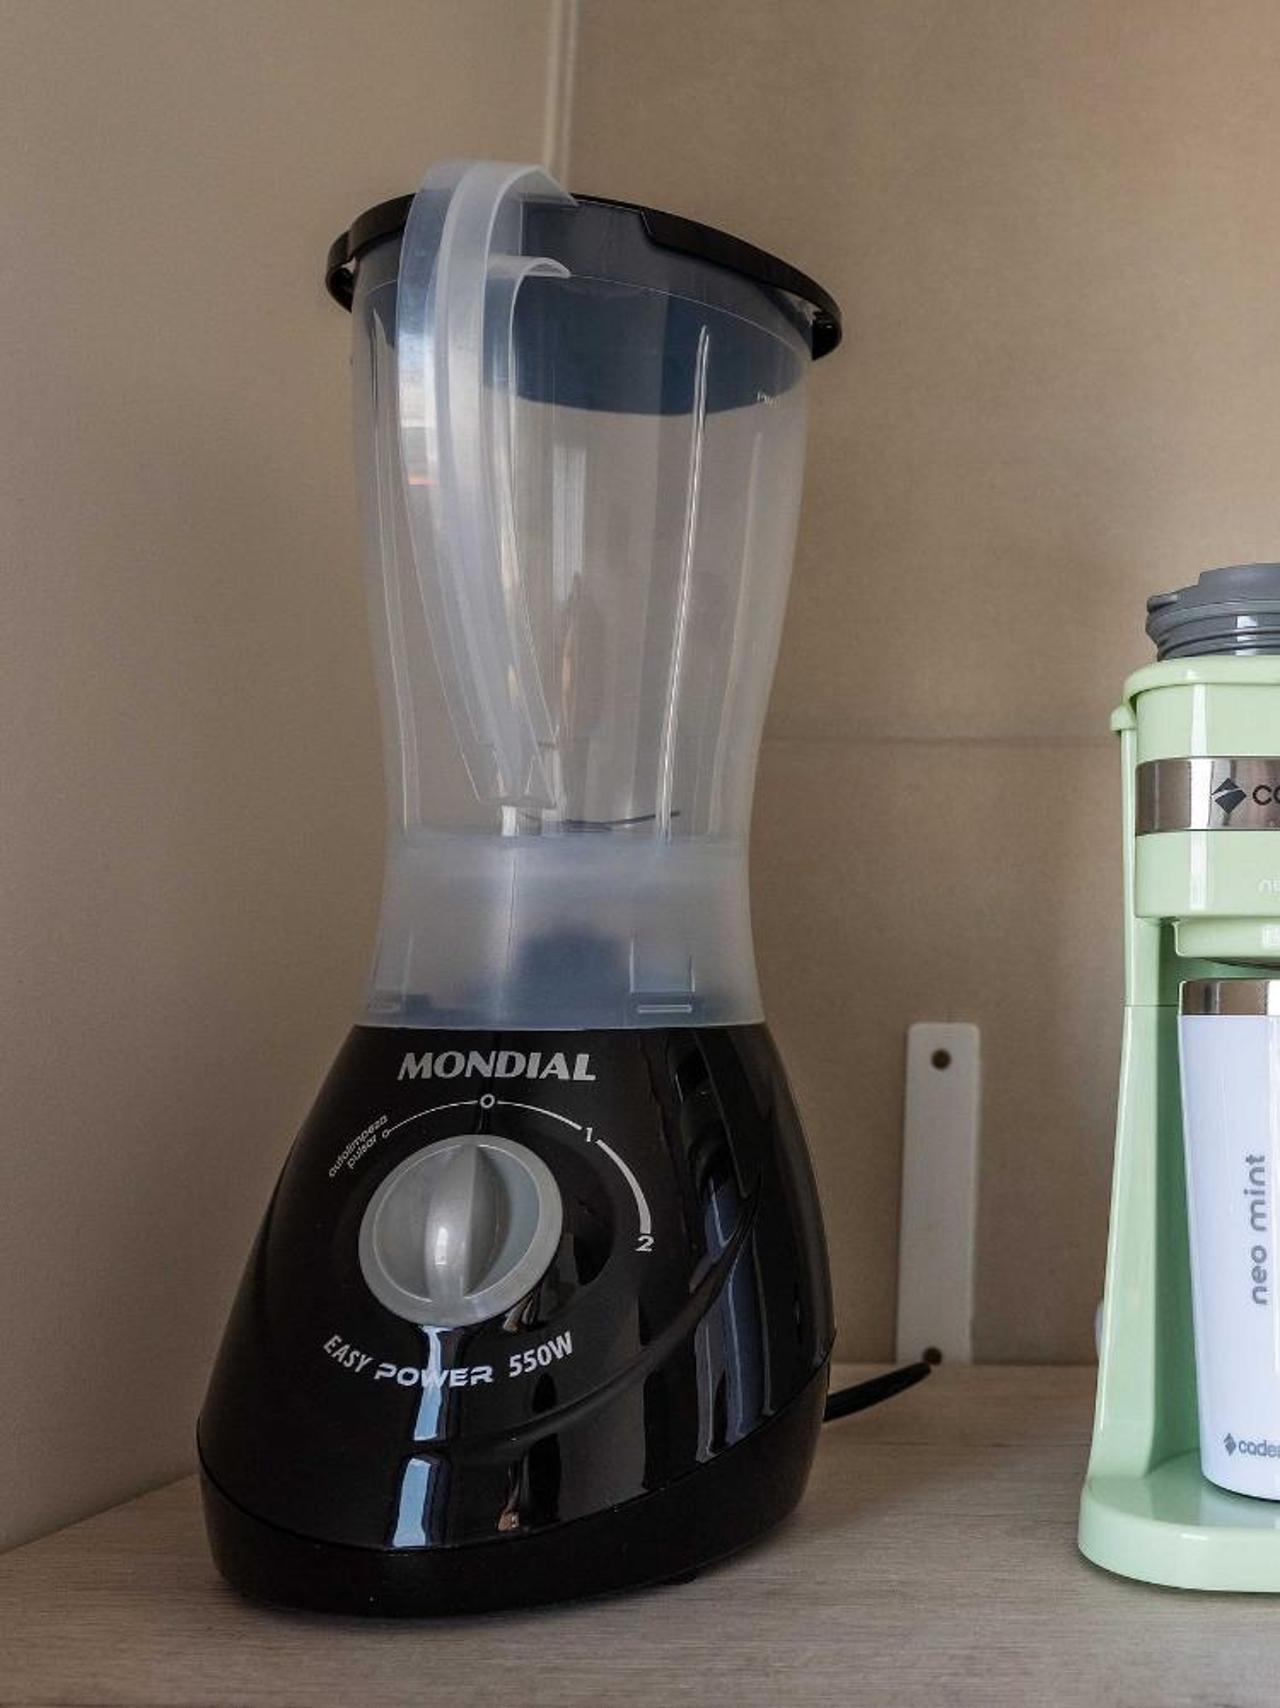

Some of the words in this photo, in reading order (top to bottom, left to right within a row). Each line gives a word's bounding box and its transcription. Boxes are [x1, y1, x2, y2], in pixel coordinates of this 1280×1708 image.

[398, 1051, 597, 1082] MONDIAL
[347, 1134, 377, 1170] pulsar
[584, 1126, 594, 1143] 1
[1244, 1154, 1268, 1231] mint
[635, 1235, 655, 1253] 2
[1251, 1244, 1268, 1305] neo
[323, 1333, 373, 1374] EASY
[373, 1362, 494, 1388] POWER
[508, 1331, 574, 1378] 550W
